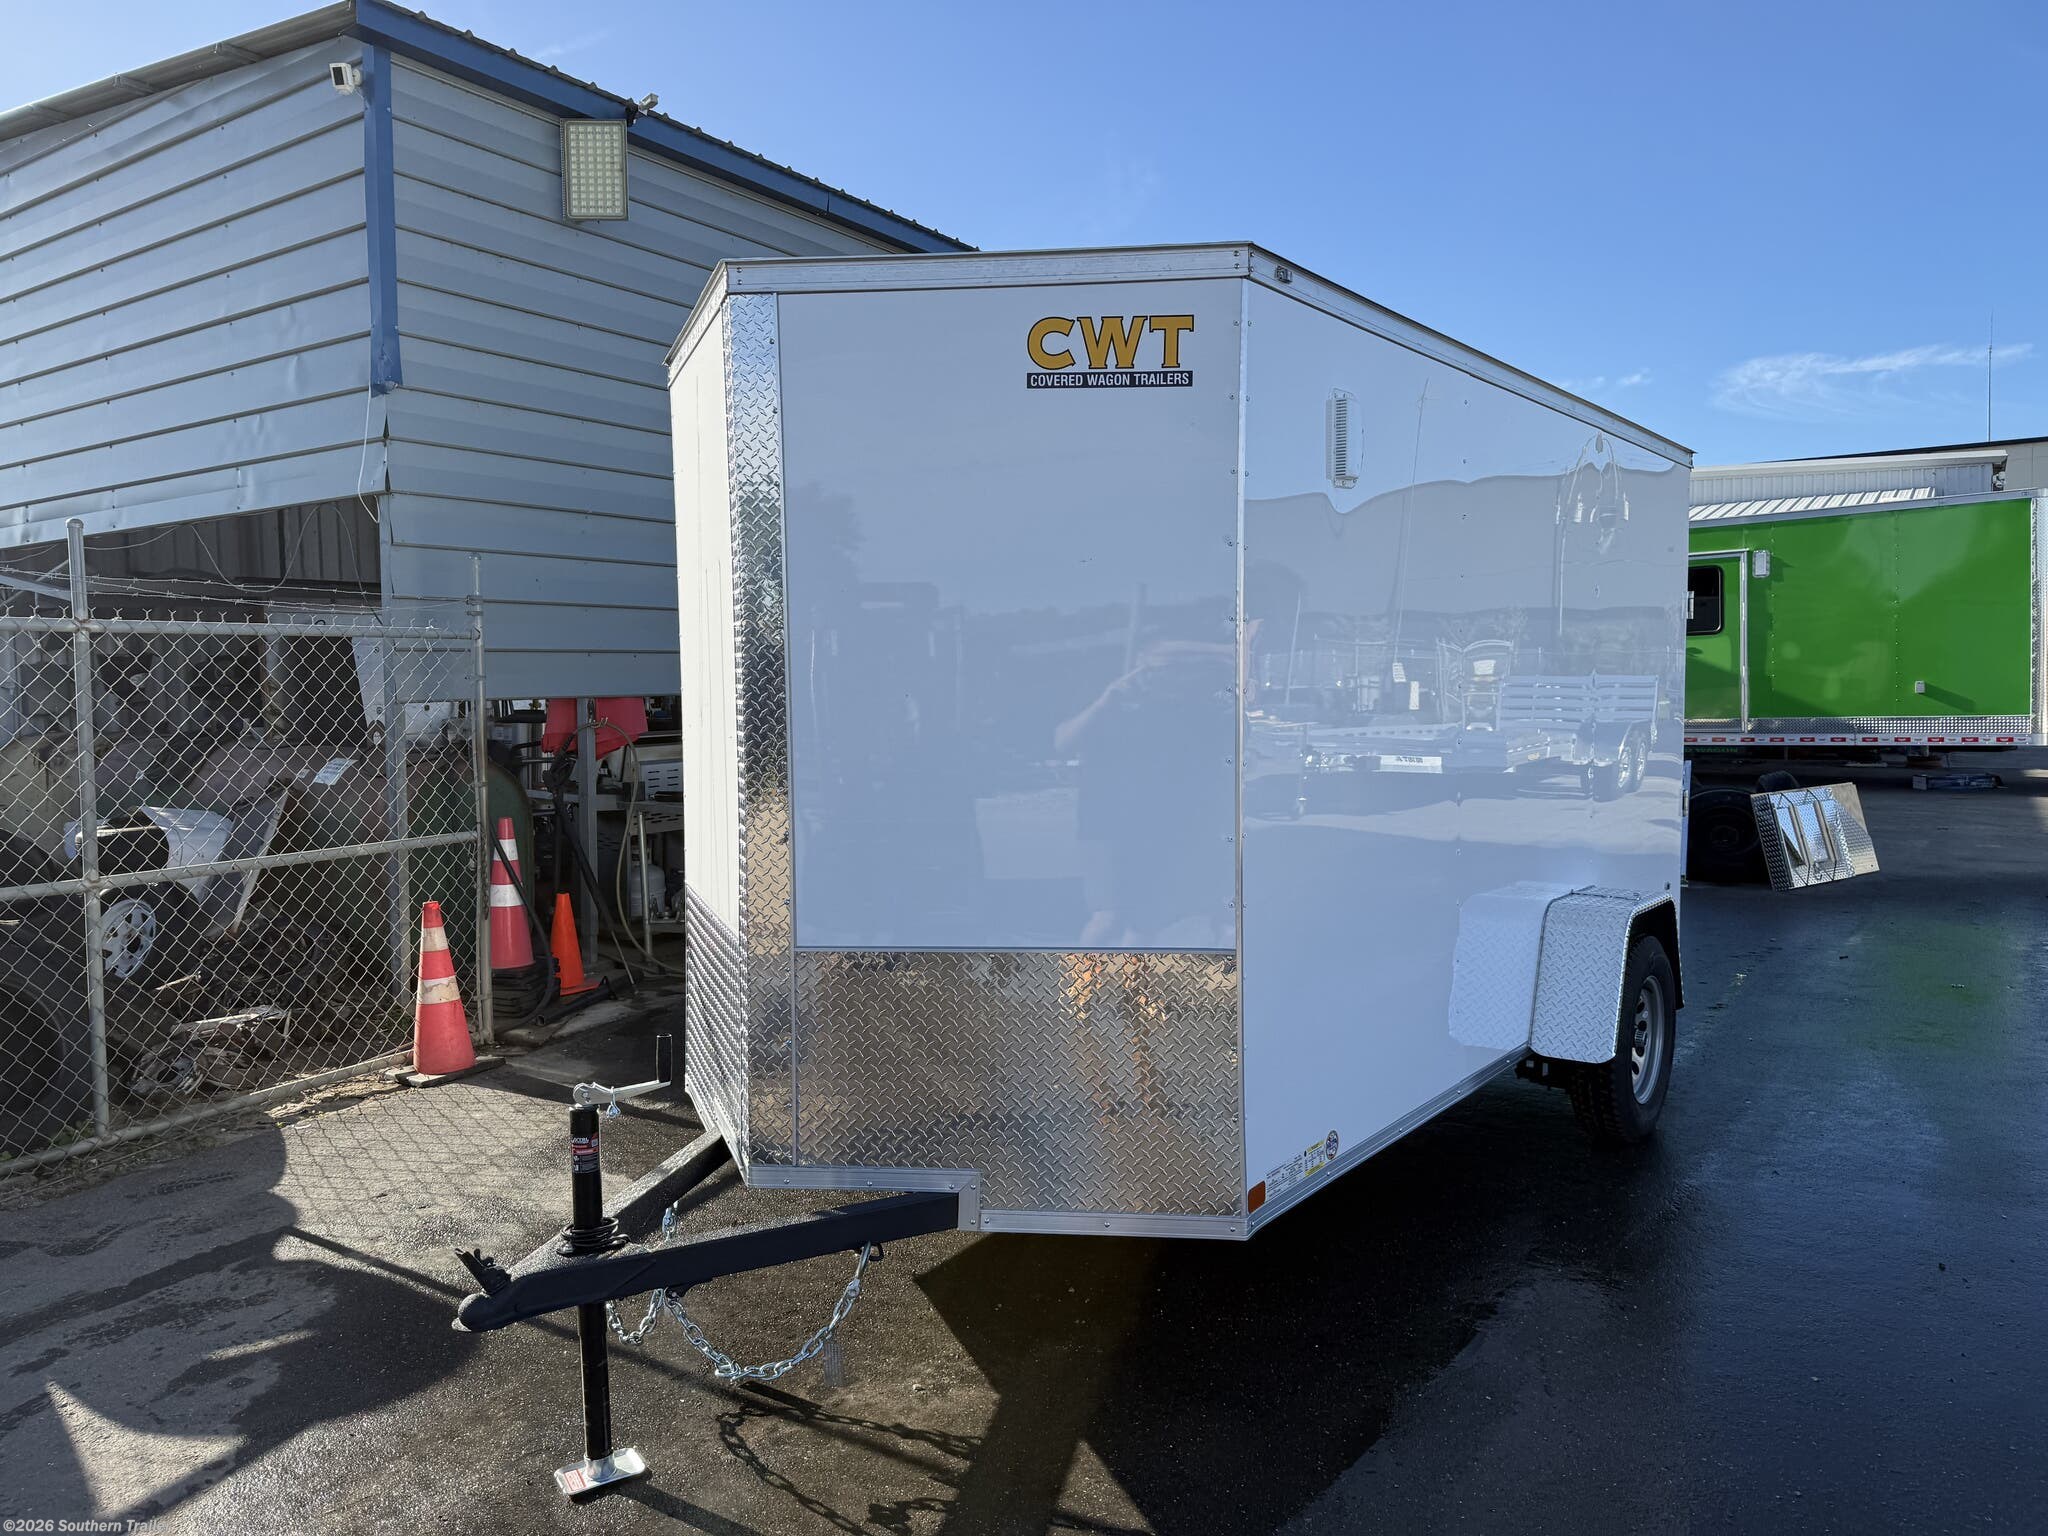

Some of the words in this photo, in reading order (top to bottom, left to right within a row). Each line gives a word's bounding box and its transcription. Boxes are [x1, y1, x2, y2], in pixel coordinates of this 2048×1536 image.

[1027, 315, 1194, 370] CWT
[1030, 374, 1083, 387] COVERED
[1087, 373, 1130, 386] WAGON
[1134, 372, 1189, 386] TRAILERS
